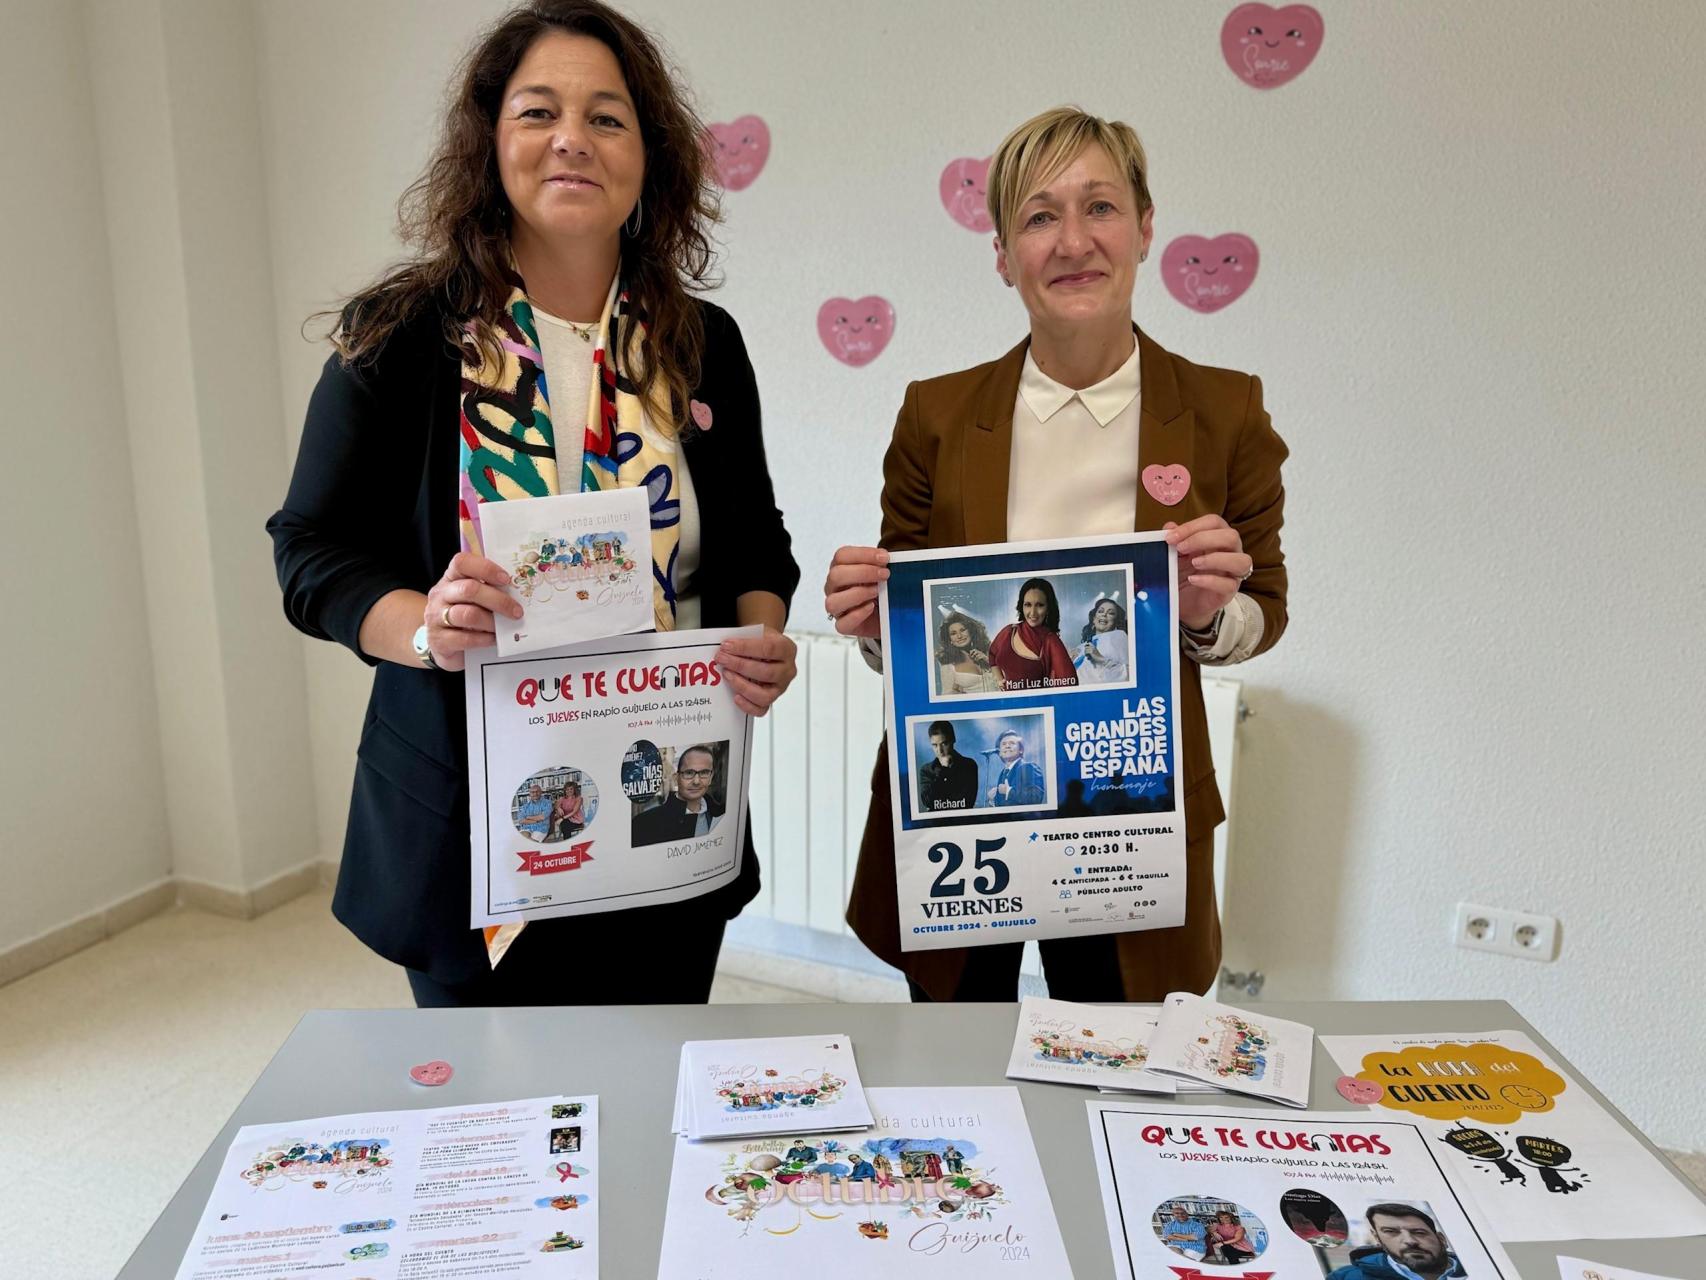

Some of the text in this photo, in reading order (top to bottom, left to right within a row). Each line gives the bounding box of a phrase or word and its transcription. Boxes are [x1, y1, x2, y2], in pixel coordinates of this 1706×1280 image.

[562, 512, 631, 530] agenda cultural
[516, 673, 574, 707] QUE
[583, 671, 607, 698] TE
[1006, 676, 1076, 690] Mari Luz Romero
[528, 716, 545, 726] LOS
[546, 710, 579, 726] JUEVES
[581, 710, 592, 720] EN
[661, 702, 667, 710] A
[668, 700, 684, 709] LAS
[1123, 696, 1166, 718] LAS
[1065, 716, 1167, 742] GRANDES
[1063, 735, 1167, 761] VOCES DE
[1080, 753, 1168, 780] ESPAÑA
[1091, 776, 1156, 794] homenaje
[933, 798, 966, 810] Richard
[1043, 826, 1174, 842] TEATRO CENTRO CULTURAL
[667, 844, 691, 859] DAVID
[1080, 842, 1139, 856] 20:30 H.
[533, 856, 577, 870] 24 OCTUBRE
[927, 836, 1010, 898] 25
[1088, 865, 1133, 874] ENTRADA:
[1068, 877, 1109, 885] ANTICIPADA
[1077, 885, 1143, 896] PÚBLICO ADULTO
[921, 896, 1023, 919] VIERNES
[913, 924, 954, 934] OCTUBRE
[957, 922, 981, 931] 2024
[991, 918, 1037, 928] GUIJUELO
[1489, 1061, 1521, 1073] del
[1387, 1083, 1490, 1103] CUENTO
[910, 1113, 982, 1128] cultural
[1141, 1125, 1209, 1147] QUE
[1214, 1127, 1249, 1148] TE
[1525, 1138, 1564, 1154] MARTES
[1159, 1152, 1178, 1160] LOS
[1180, 1152, 1219, 1162] JUEVES
[1221, 1154, 1234, 1163] EN
[1331, 1161, 1350, 1169] LAS
[908, 1221, 1027, 1256] Guijuelo
[1000, 1246, 1030, 1261] 2024
